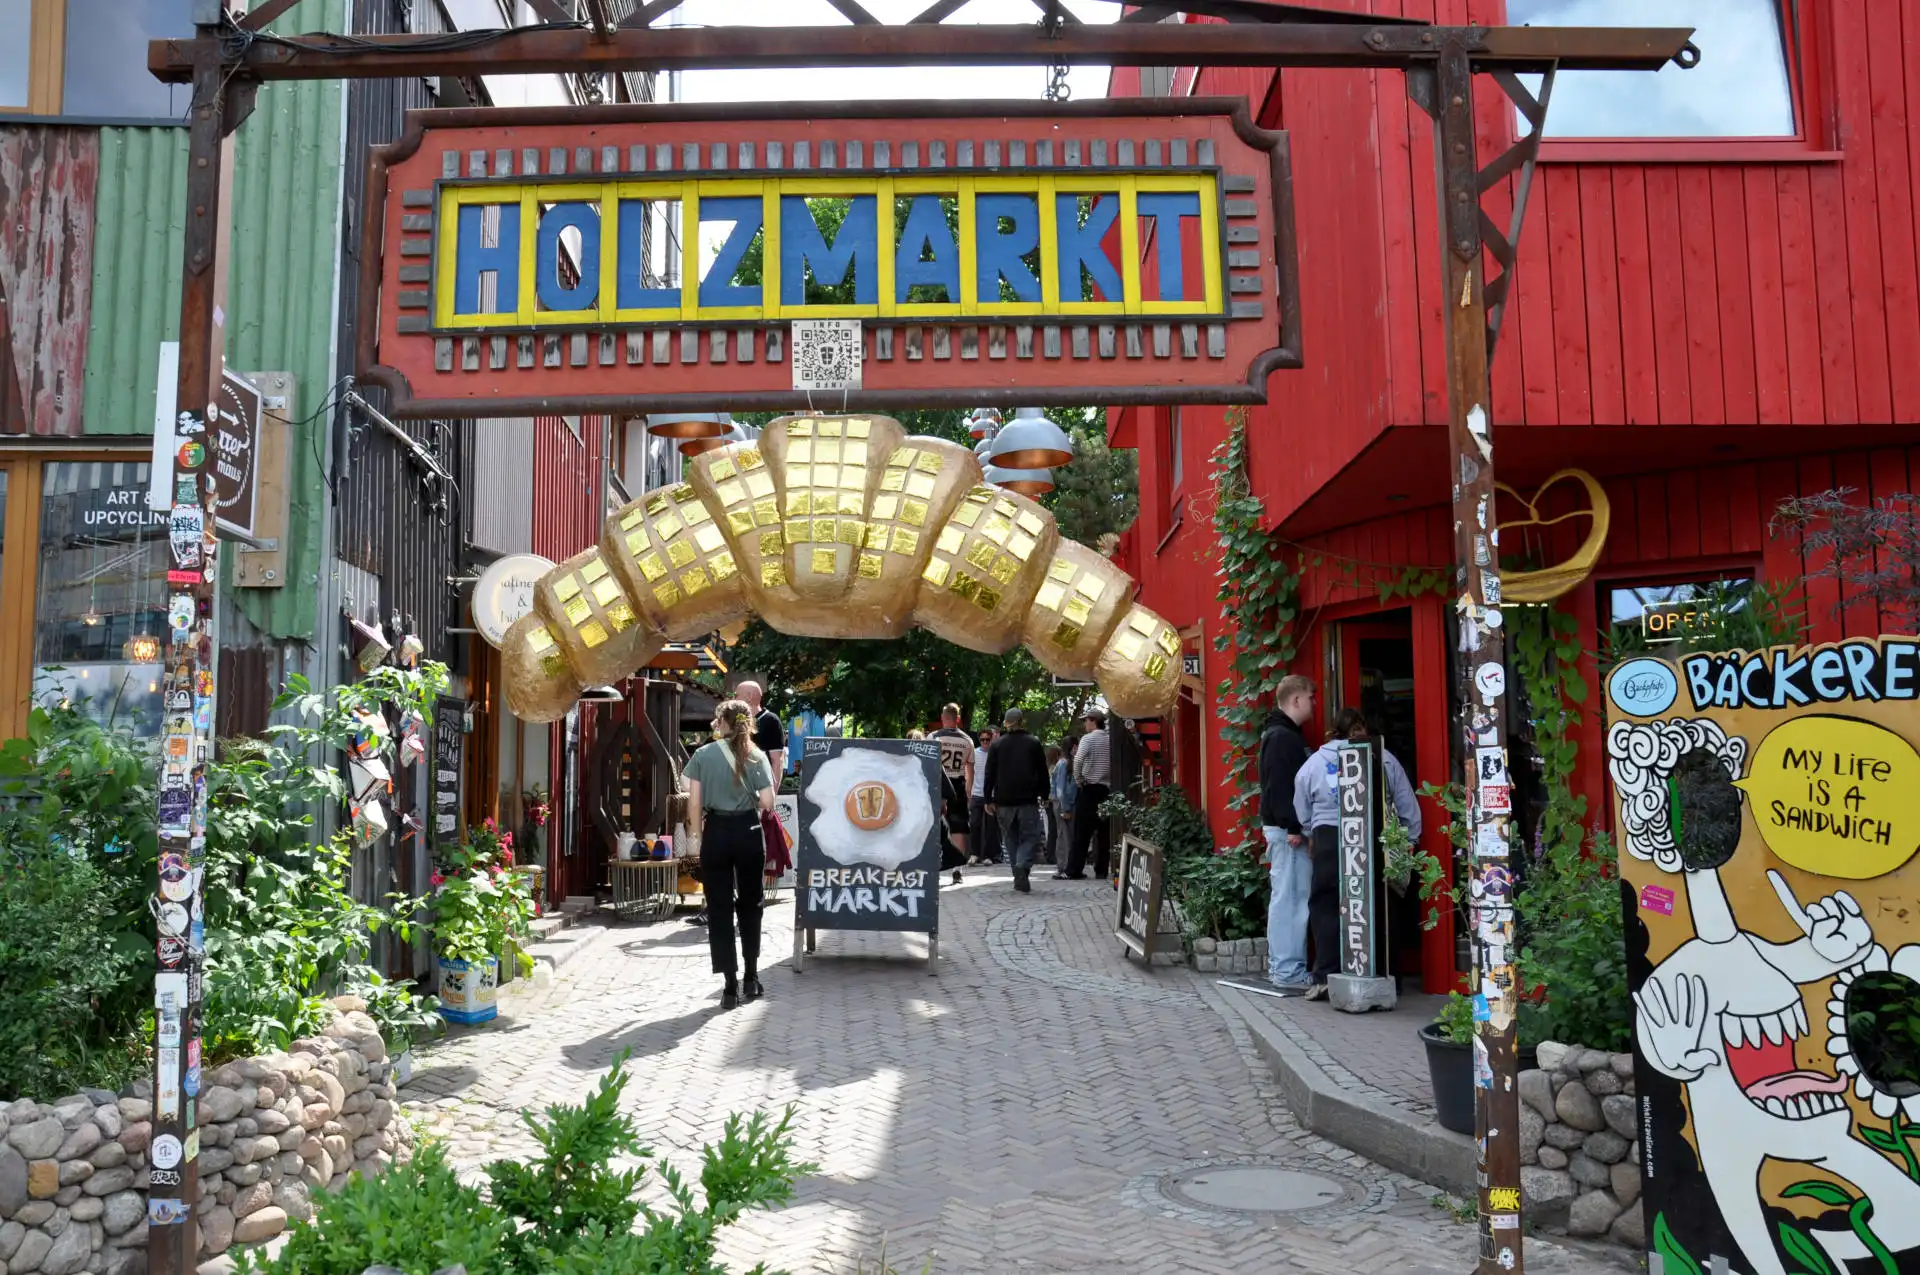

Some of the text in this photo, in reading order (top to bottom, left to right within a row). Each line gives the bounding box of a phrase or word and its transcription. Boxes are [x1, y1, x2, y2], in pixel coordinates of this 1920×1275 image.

[456, 192, 1200, 314] HOLZMARKT
[106, 491, 153, 505] ART &
[1687, 643, 1920, 707] BÄCKeRE
[941, 749, 963, 769] 26
[1843, 785, 1867, 812] A
[808, 867, 928, 888] BREAKFAST
[807, 887, 926, 917] MARKT
